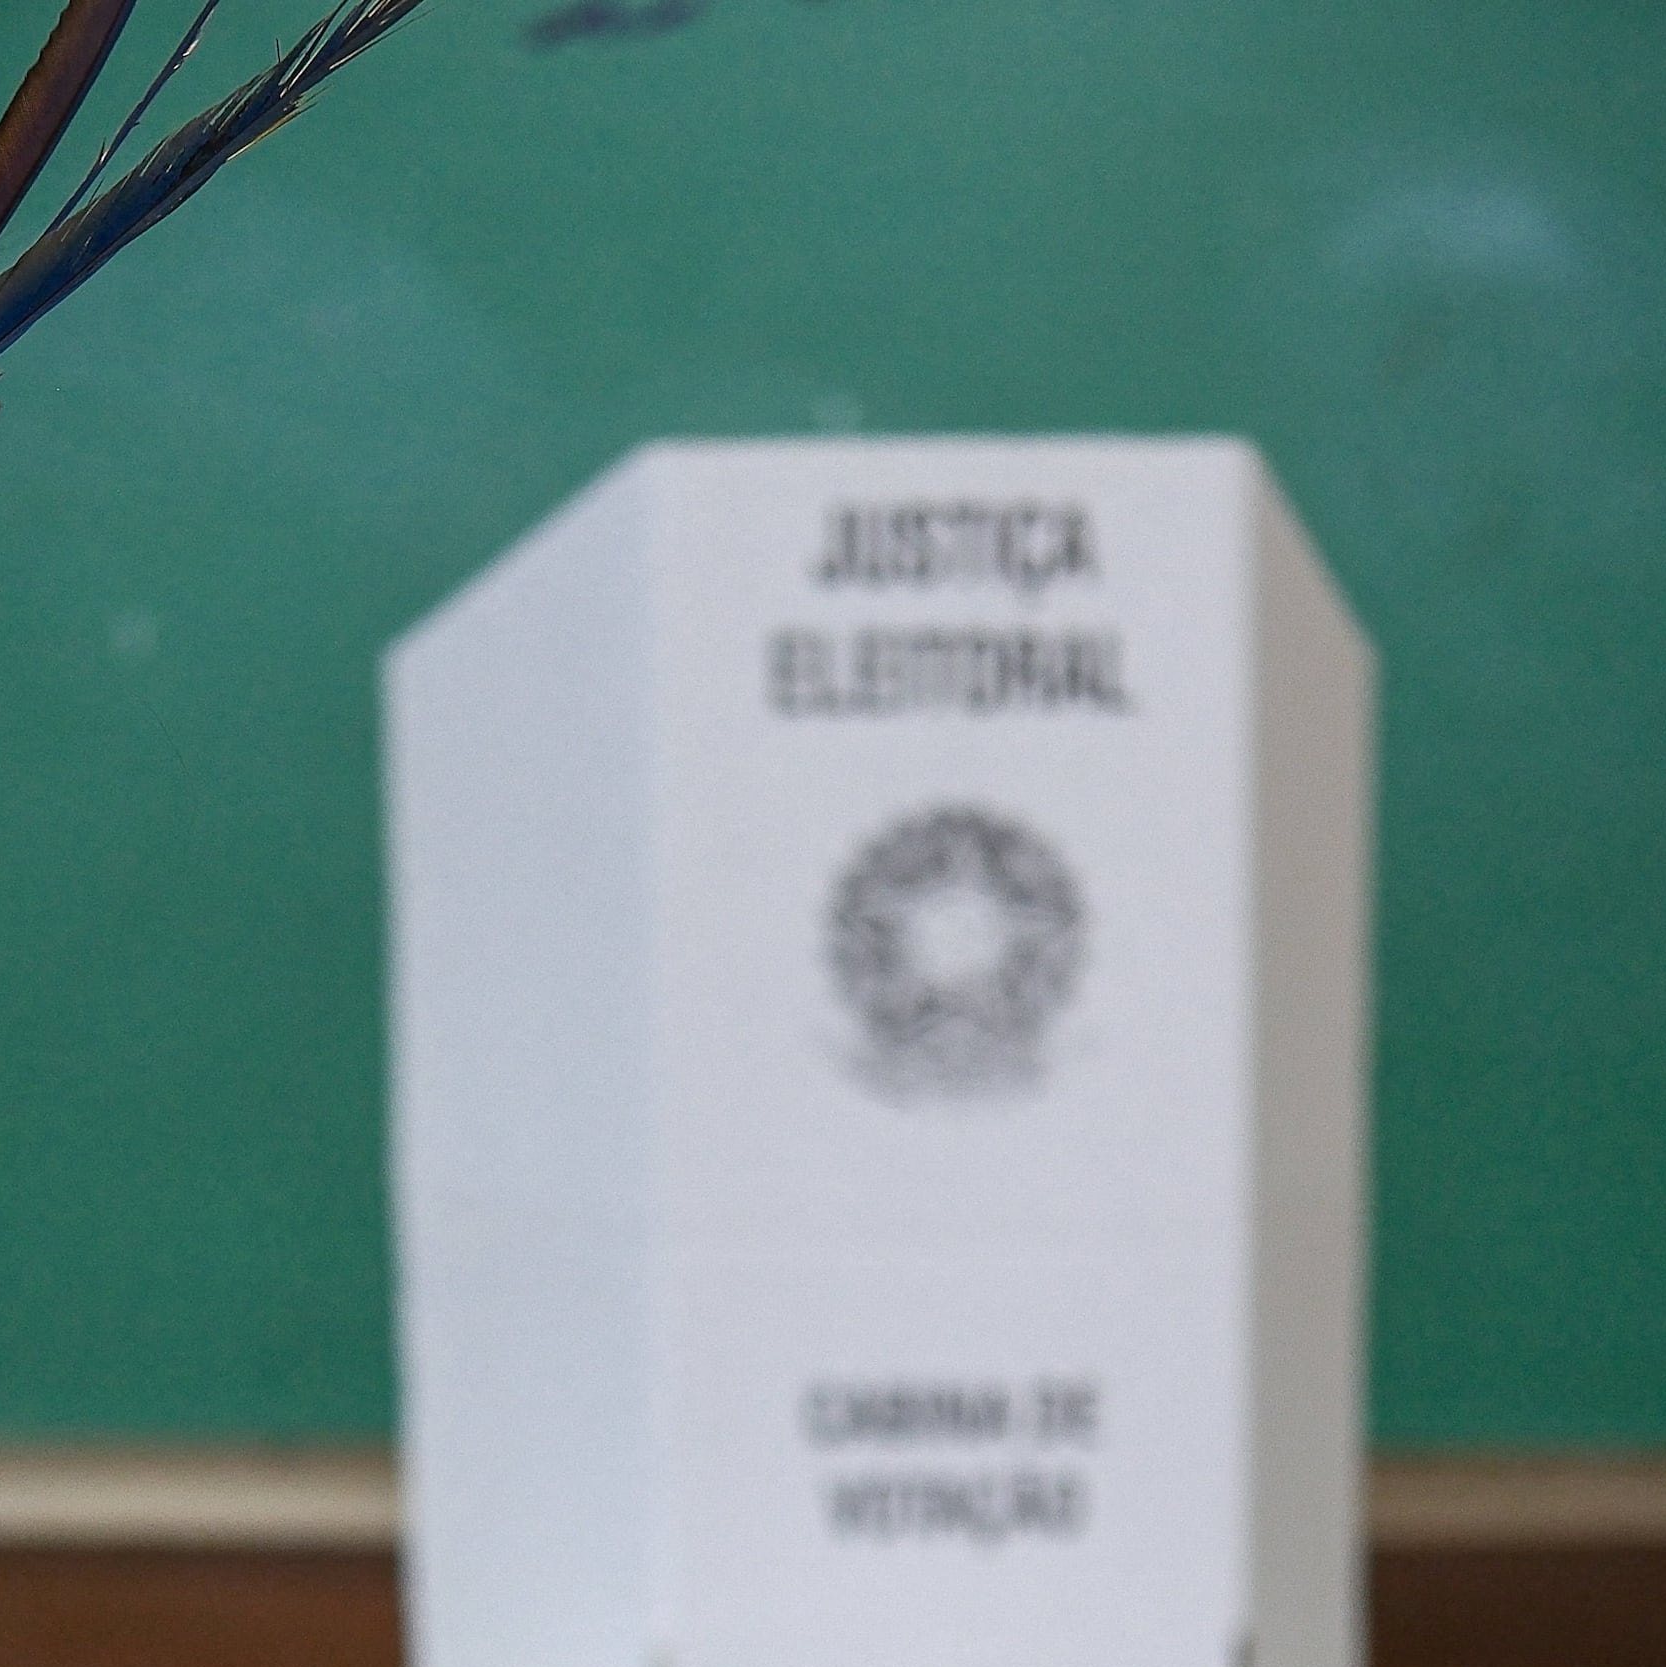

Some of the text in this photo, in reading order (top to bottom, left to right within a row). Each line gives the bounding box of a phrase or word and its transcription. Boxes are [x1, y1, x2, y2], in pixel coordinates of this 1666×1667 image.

[811, 504, 1097, 598] JUSTIÇA
[766, 627, 1135, 715] ELEITORAL
[824, 1472, 1093, 1546] VOTAÇÃO
